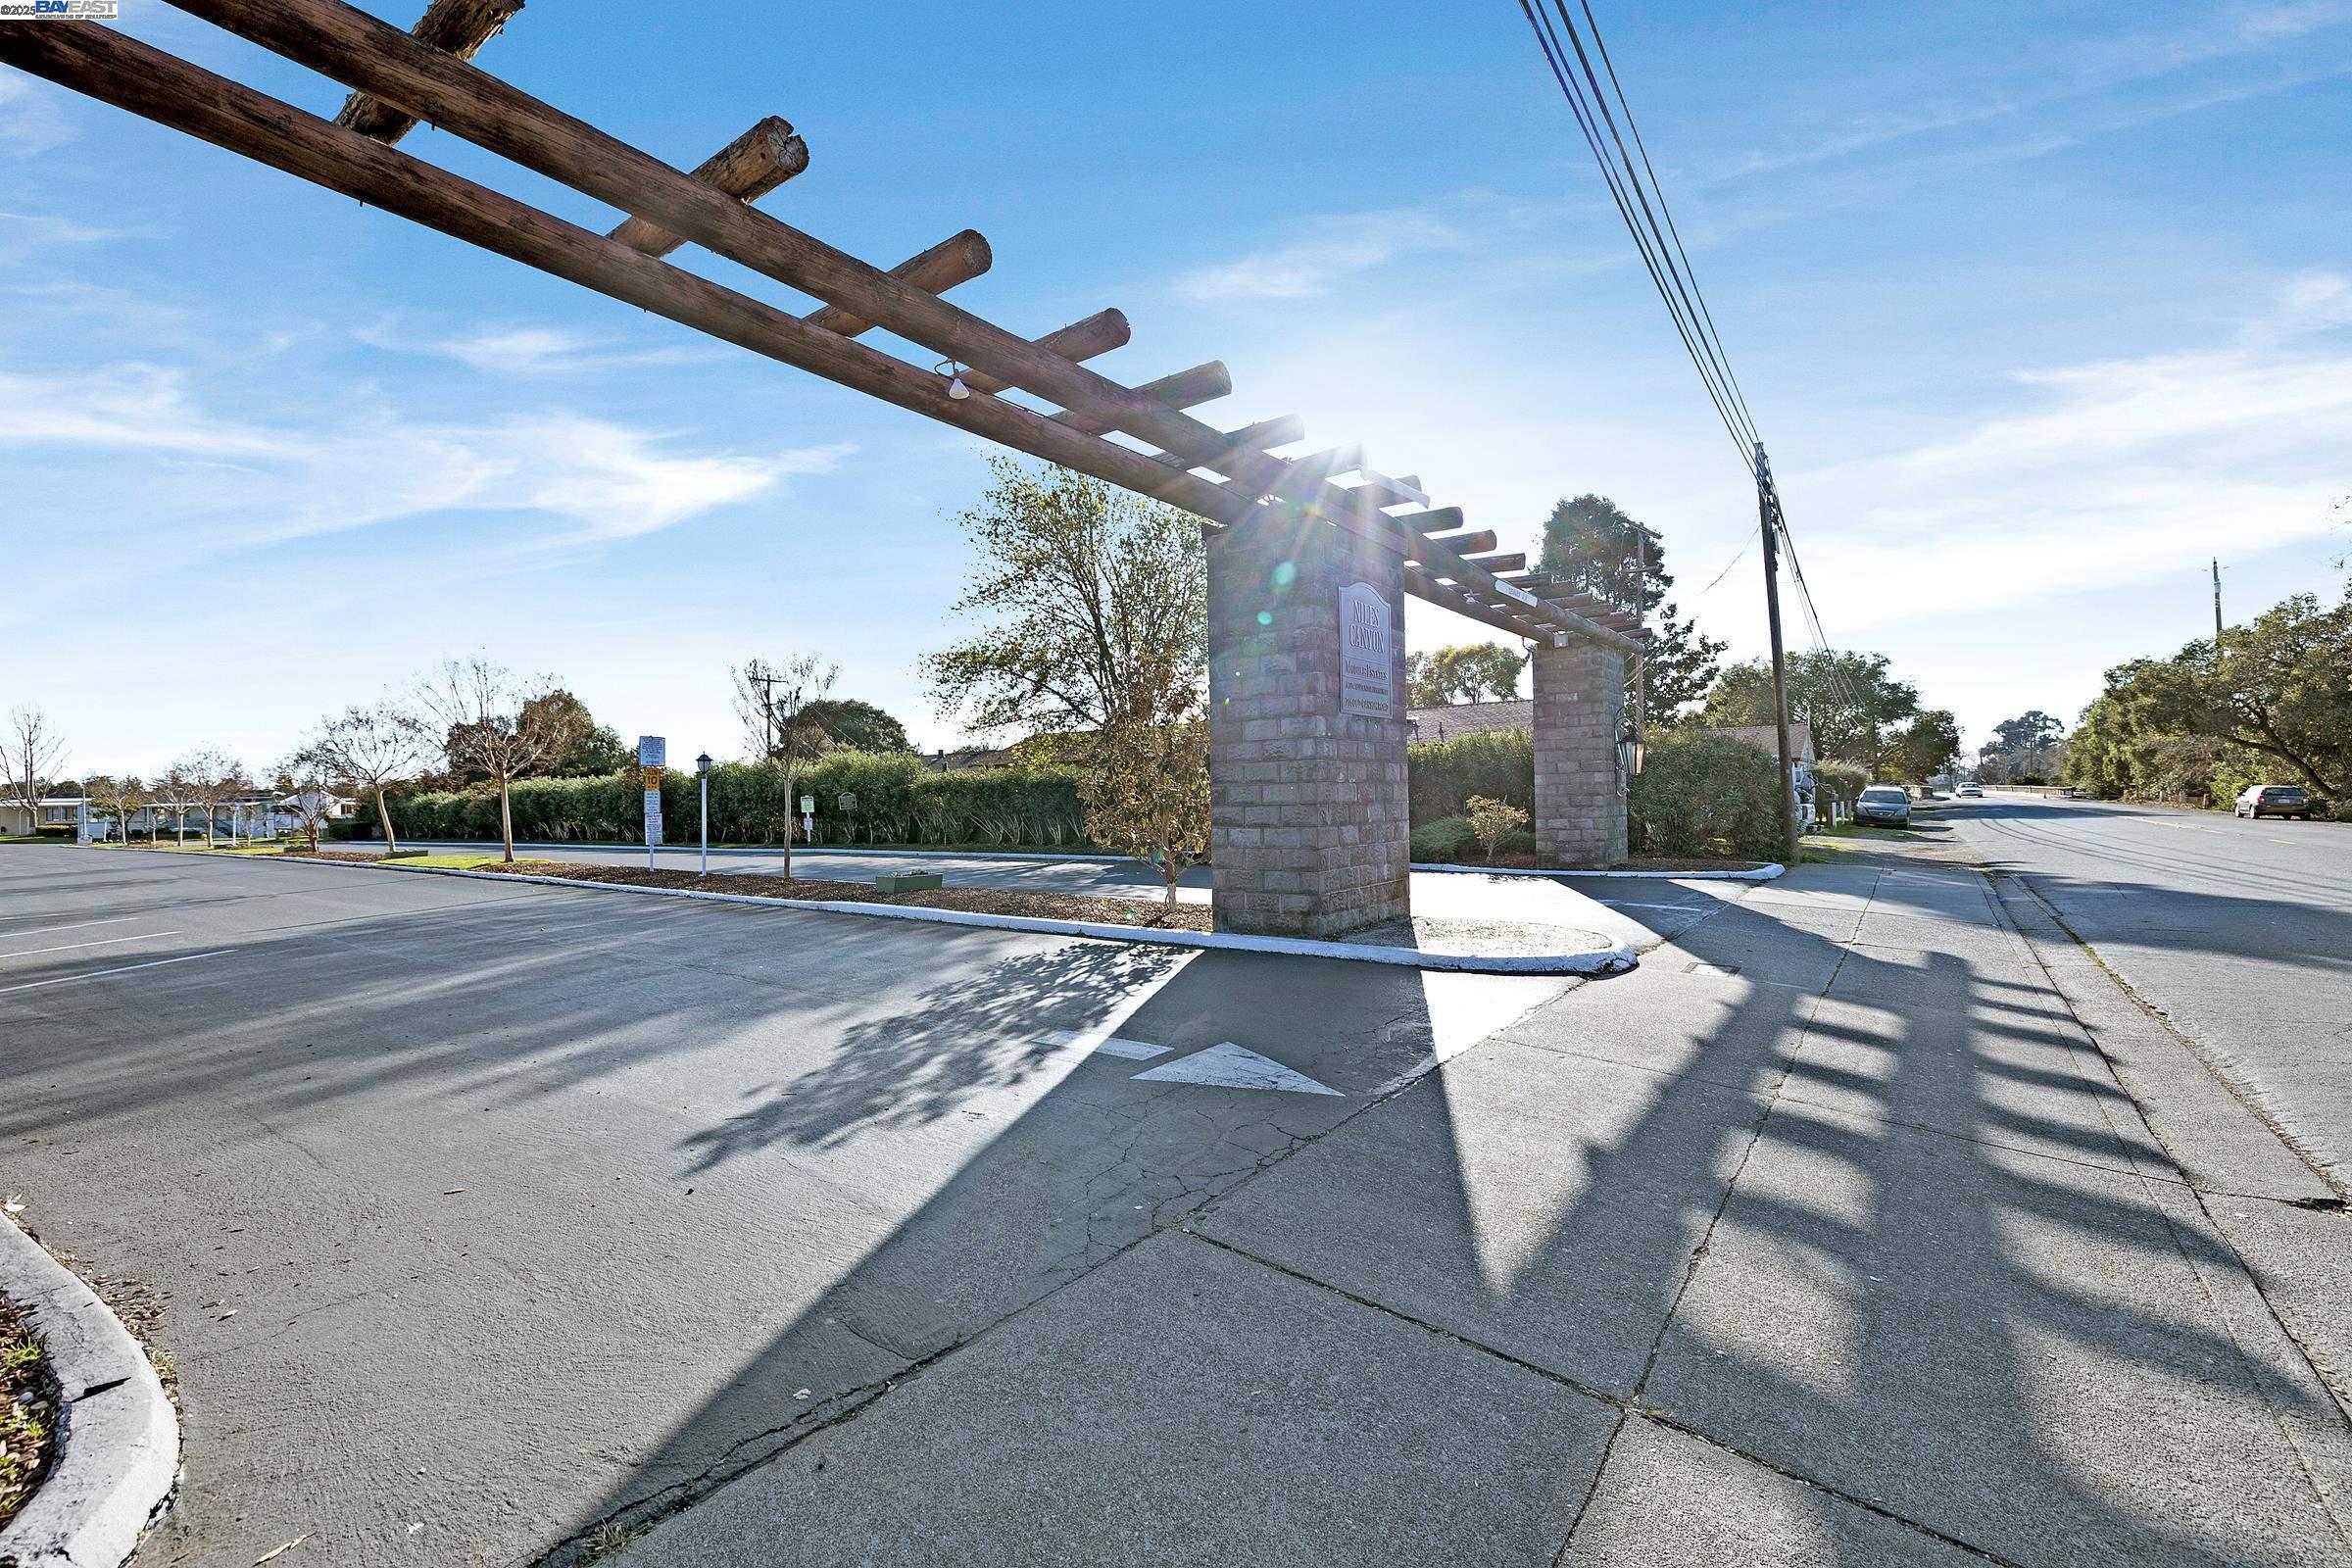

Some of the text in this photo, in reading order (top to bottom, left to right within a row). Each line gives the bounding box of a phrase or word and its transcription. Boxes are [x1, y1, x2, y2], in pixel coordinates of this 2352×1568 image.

[1353, 600, 1380, 628] NILES
[1349, 623, 1385, 653] CANYON
[647, 776, 658, 785] 10
